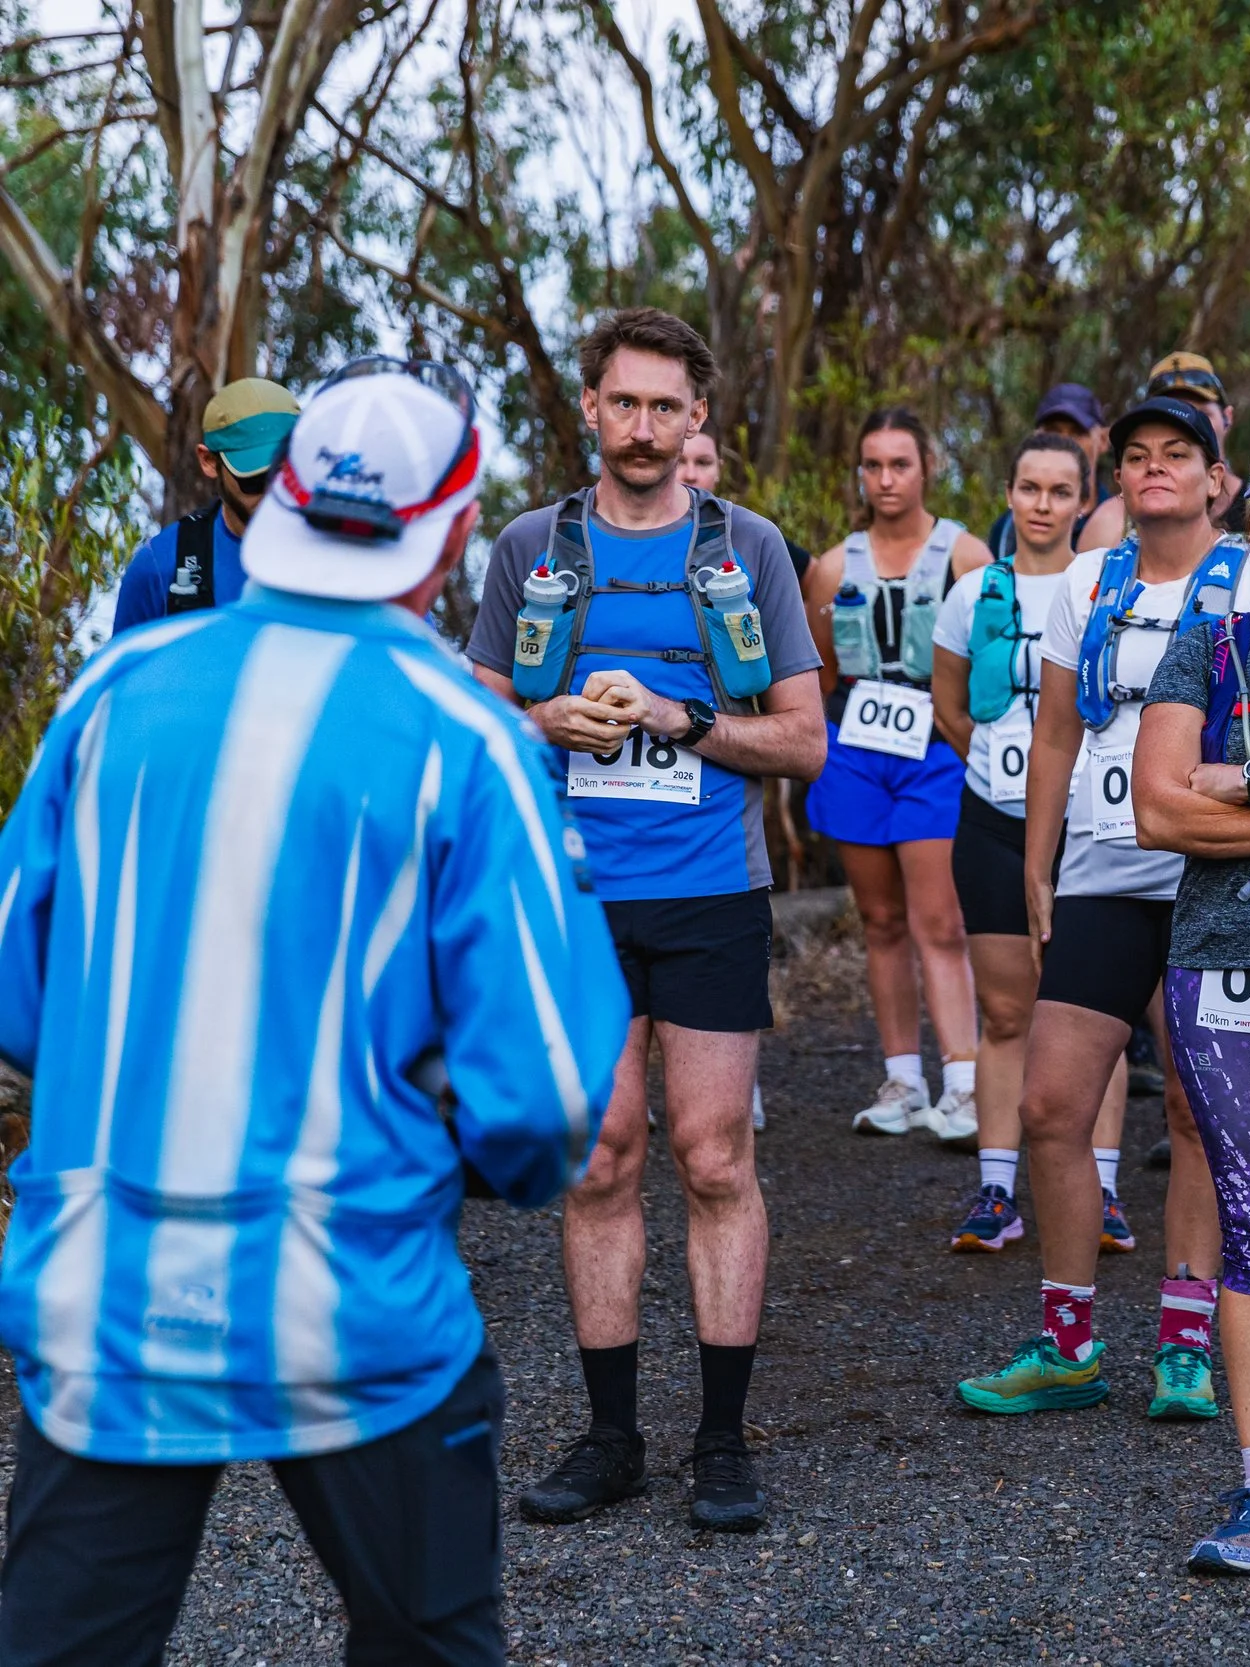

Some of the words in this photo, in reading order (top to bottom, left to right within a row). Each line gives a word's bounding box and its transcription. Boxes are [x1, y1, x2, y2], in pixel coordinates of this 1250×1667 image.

[860, 699, 915, 732] 010
[1096, 751, 1133, 763] Tamworth
[673, 771, 694, 781] 2026
[574, 777, 598, 788] 10km
[1098, 821, 1117, 832] 10km
[1203, 1012, 1230, 1027] 10km
